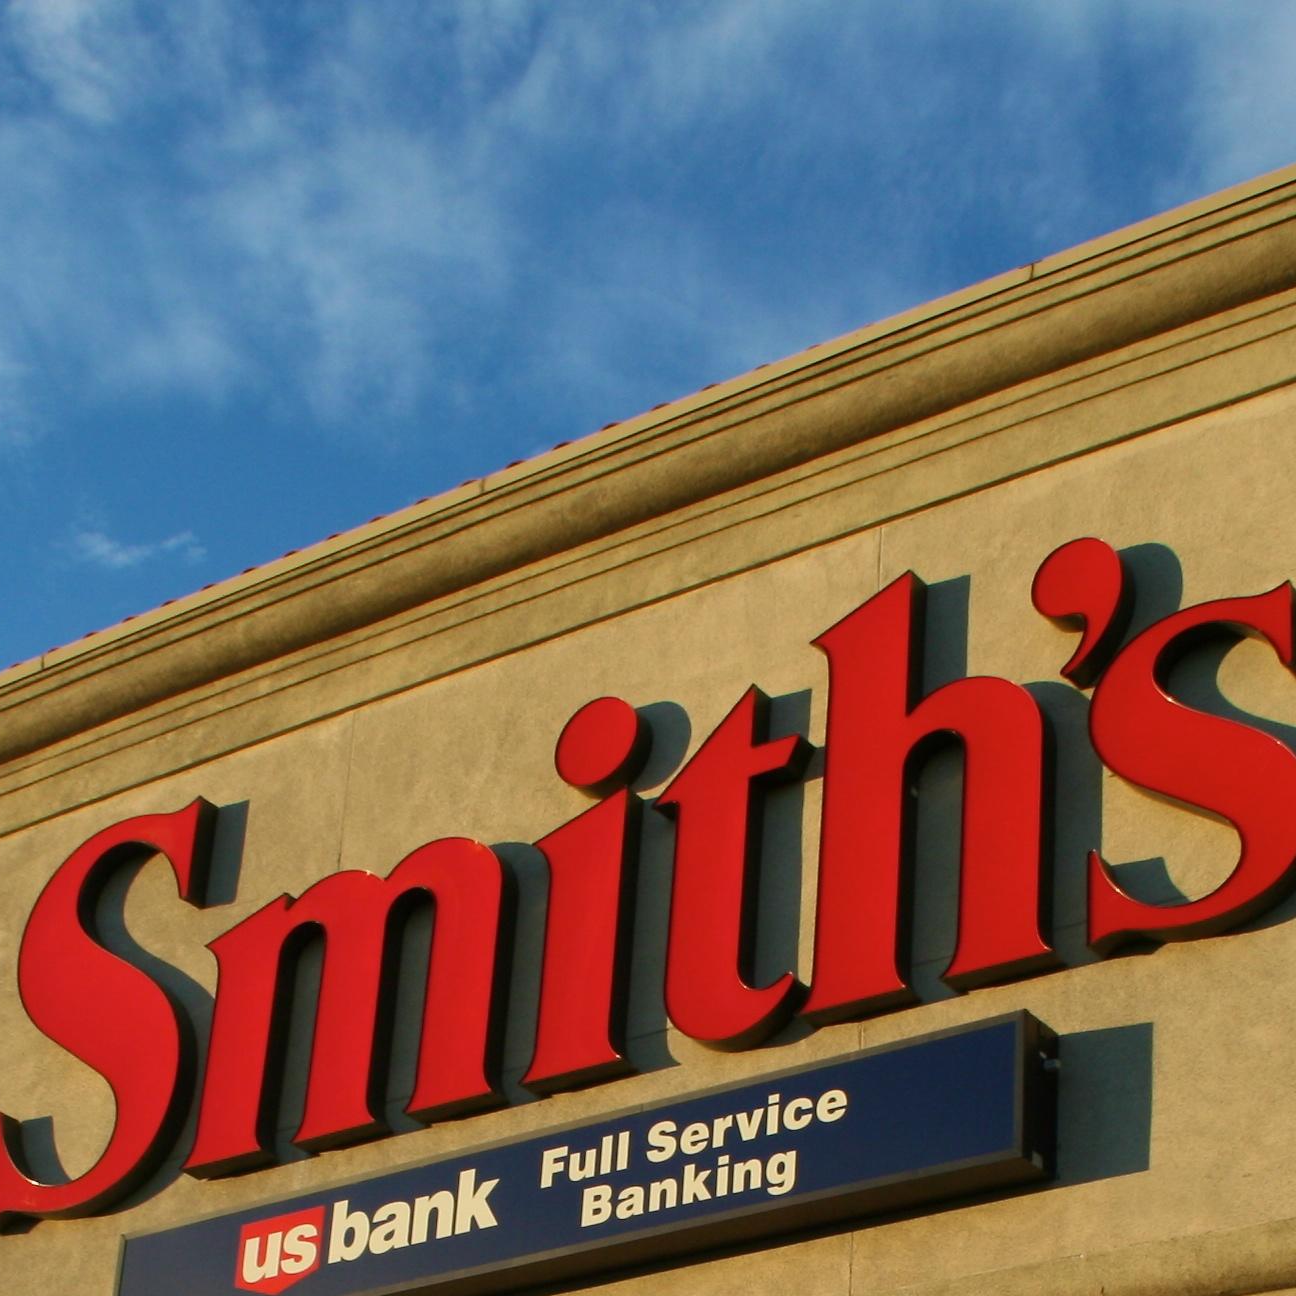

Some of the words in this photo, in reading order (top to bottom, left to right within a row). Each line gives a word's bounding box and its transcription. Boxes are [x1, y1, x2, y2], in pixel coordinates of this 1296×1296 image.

[539, 1130, 631, 1189] Full
[646, 1087, 849, 1164] Service
[580, 1150, 798, 1228] Banking
